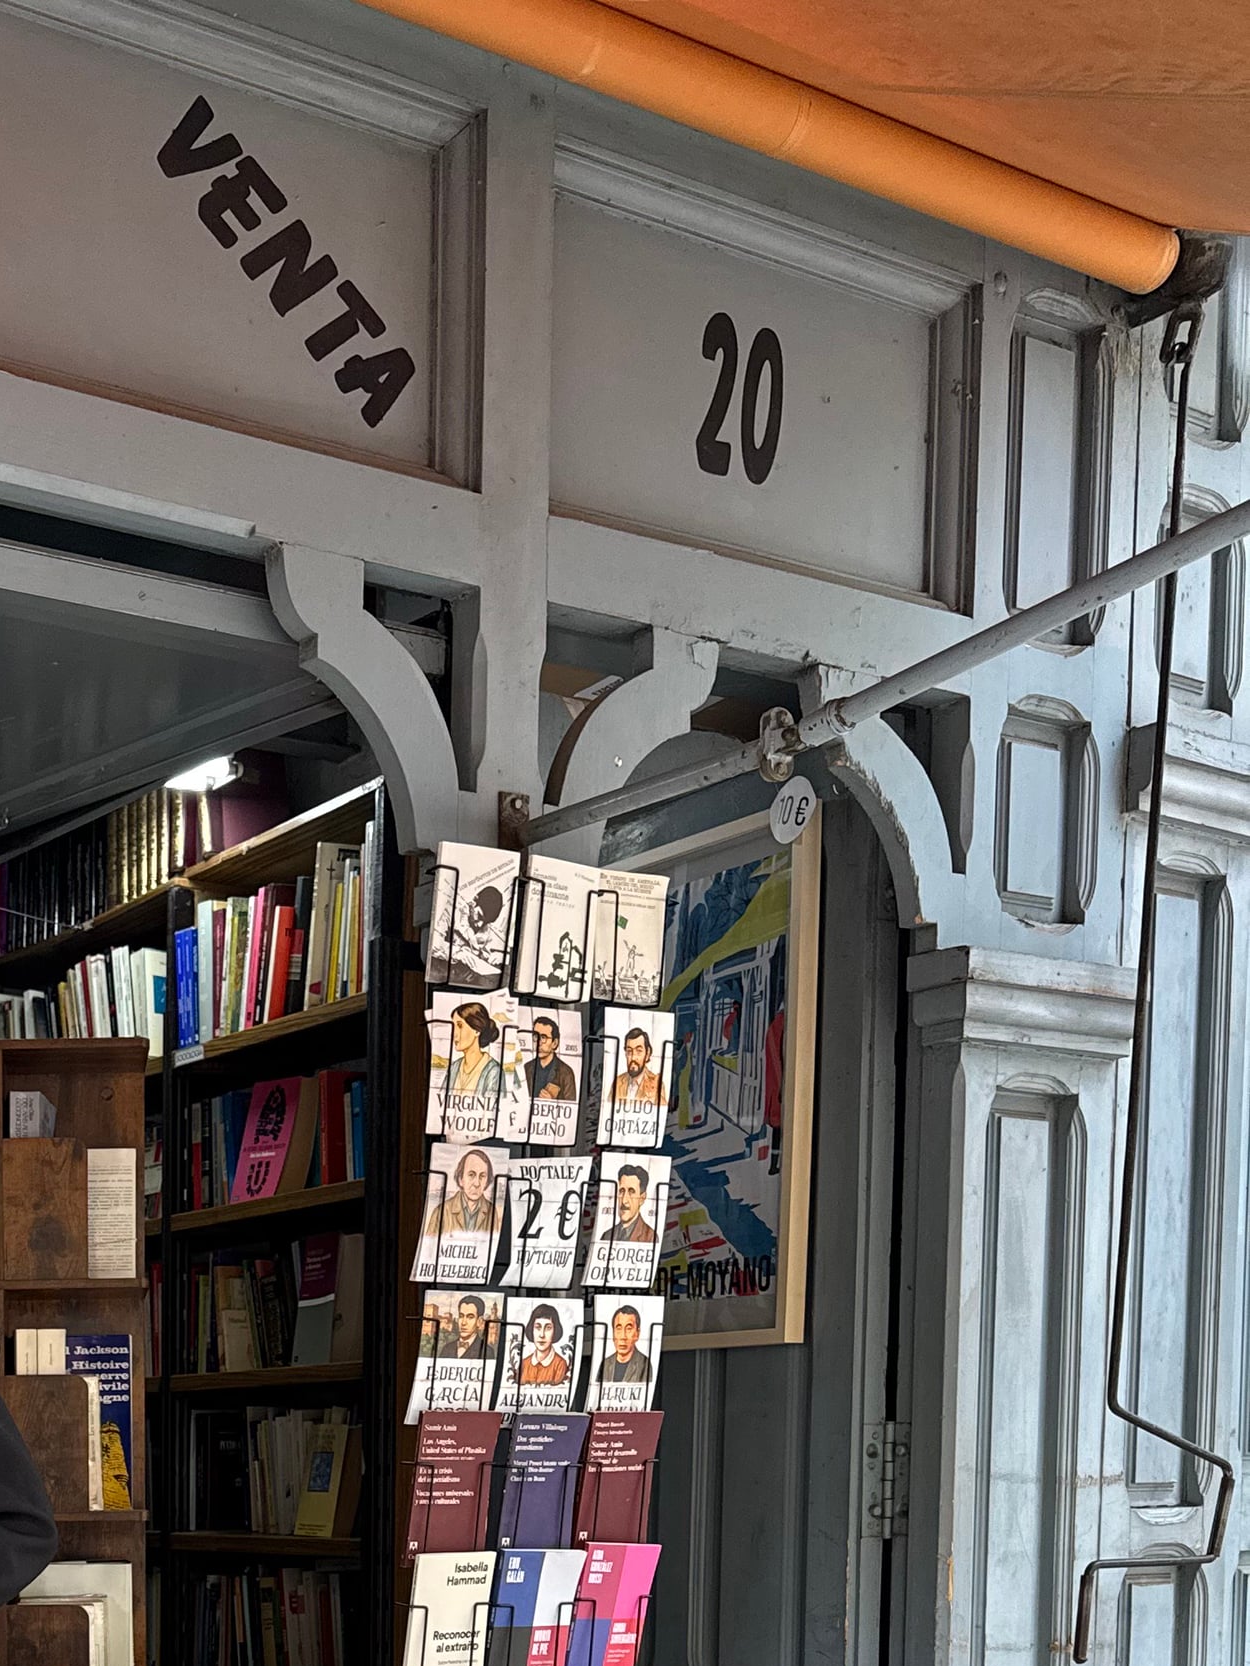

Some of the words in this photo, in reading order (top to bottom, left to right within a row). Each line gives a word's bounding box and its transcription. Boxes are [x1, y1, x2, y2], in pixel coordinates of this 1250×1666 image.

[156, 95, 416, 429] VENTA
[696, 312, 784, 486] 20
[779, 794, 794, 826] 10
[795, 796, 809, 827] €
[436, 1091, 501, 1114] VIRGINIA
[615, 1098, 654, 1116] JULIO
[438, 1113, 496, 1133] WOOLF
[519, 1164, 584, 1184] POSTALES
[517, 1187, 544, 1240] 2
[554, 1188, 584, 1241] €
[439, 1244, 479, 1260] MICHEL
[597, 1246, 655, 1266] GEORGE
[590, 1266, 652, 1283] ORWELL
[657, 1265, 682, 1302] DE
[686, 1253, 772, 1302] MOYANO
[73, 1345, 130, 1356] Jackson
[70, 1360, 130, 1371] Histoire
[425, 1383, 479, 1402] GARCÍA
[519, 1423, 541, 1431] Lorenzo
[422, 1446, 440, 1454] United
[440, 1446, 458, 1454] States
[454, 1562, 489, 1574] Isabella
[446, 1574, 487, 1587] Hammad
[432, 1628, 481, 1643] Reconocer
[436, 1643, 446, 1654] al
[446, 1641, 480, 1654] extraño
